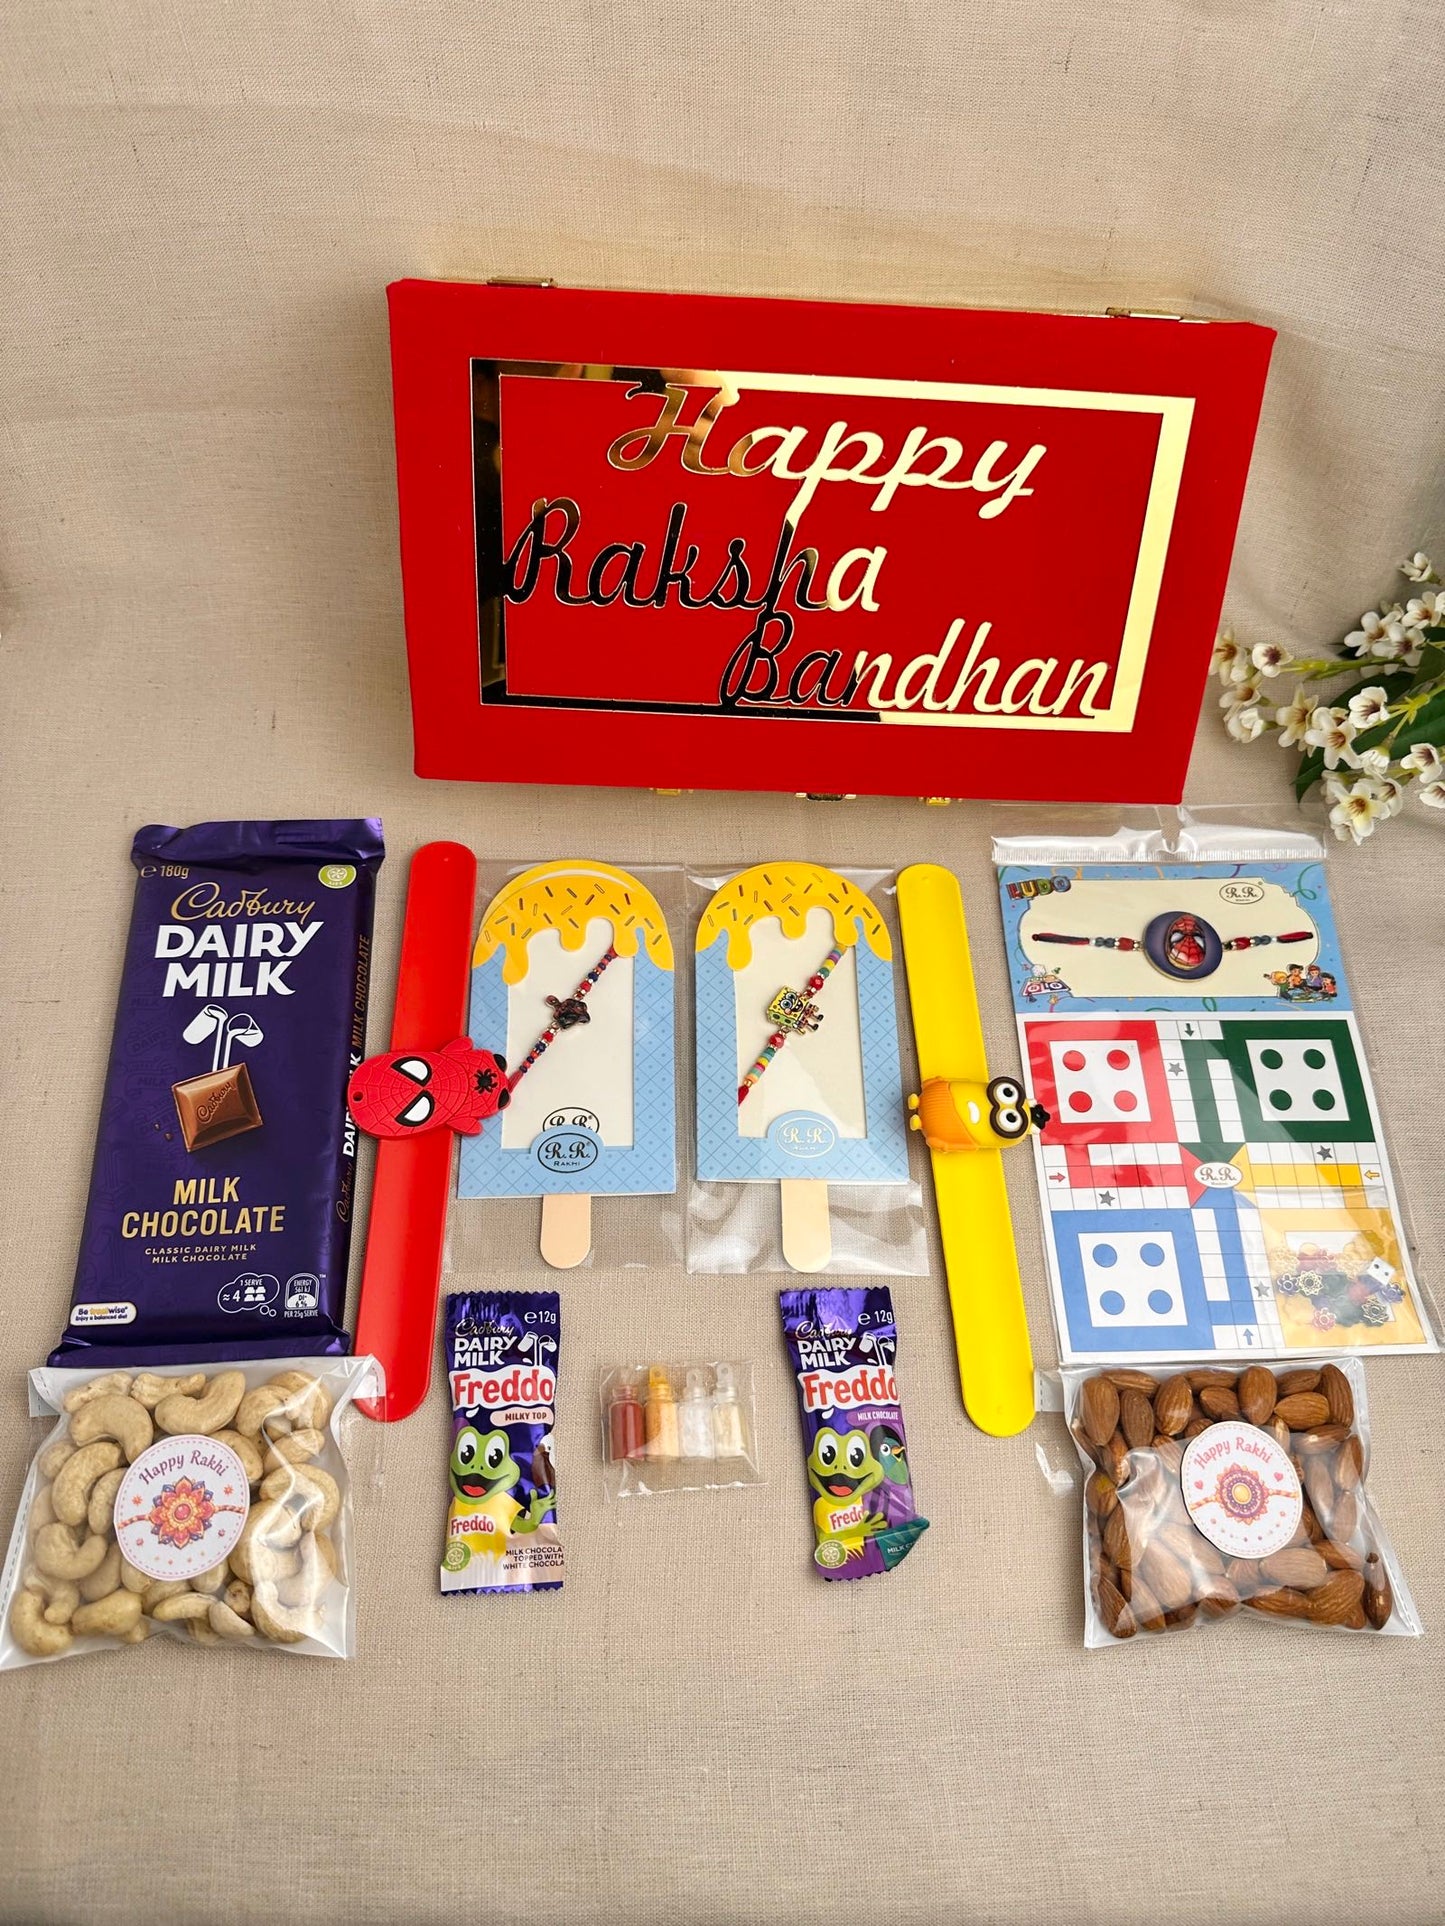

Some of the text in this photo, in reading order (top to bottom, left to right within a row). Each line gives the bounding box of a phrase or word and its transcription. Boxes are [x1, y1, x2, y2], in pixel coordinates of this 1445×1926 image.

[607, 382, 1047, 530] Happy
[503, 496, 888, 613] Raksha
[719, 608, 1113, 718] Bandhan
[160, 865, 190, 880] 180g
[1006, 875, 1072, 901] LUDO
[171, 881, 316, 925] Cadbury
[154, 921, 324, 959] DAIRY
[162, 960, 296, 998] MILK
[354, 934, 370, 1012] CHOCOLATE
[351, 1013, 364, 1049] MILK
[173, 1176, 241, 1205] MILK
[121, 1206, 286, 1239] CHOCOLATE
[144, 1243, 257, 1255] CLASSIC DAIRY MILK
[152, 1253, 248, 1264] MILK CHOCOLATE
[232, 1290, 241, 1302] 4
[455, 1317, 514, 1337] Cadbury
[538, 1310, 557, 1325] 12g
[874, 1309, 893, 1325] 12g
[454, 1336, 518, 1352] DAIRY
[797, 1337, 857, 1354] DAIRY
[454, 1350, 505, 1368] MILK
[800, 1351, 851, 1370] MILK
[453, 1369, 553, 1407] Freddo
[505, 1411, 547, 1421] MILKY TOP
[857, 1410, 899, 1421] MILK CHOCOLATE
[1194, 1436, 1273, 1470] Happy Rakhi
[139, 1449, 229, 1485] Happy Rakhi
[451, 1516, 494, 1536] Freddo
[505, 1549, 524, 1557] MILK
[513, 1553, 564, 1563] TOPPED WITH
